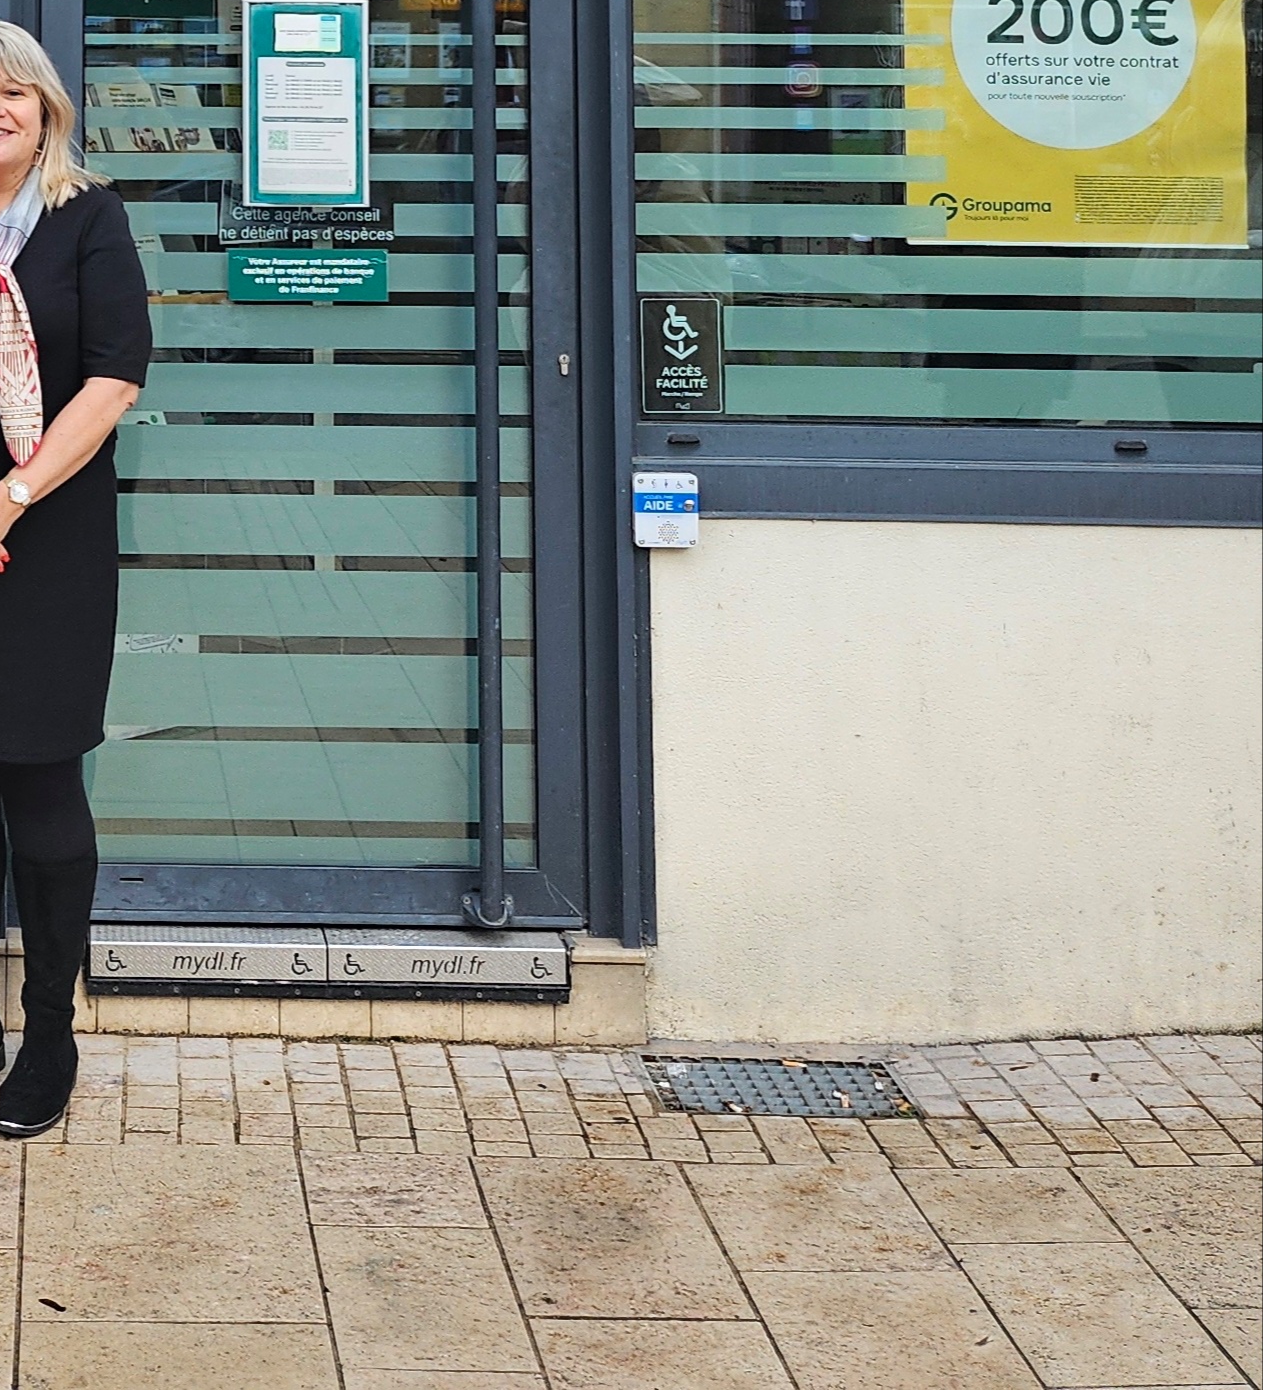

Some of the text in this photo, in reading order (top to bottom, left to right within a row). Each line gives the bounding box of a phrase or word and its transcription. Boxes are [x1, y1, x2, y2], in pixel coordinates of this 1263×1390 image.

[986, 53, 1180, 69] offerts sur votre contrat
[986, 72, 1111, 86] d'assurance vie
[987, 94, 1007, 102] pour
[1009, 92, 1033, 101] toute
[1034, 92, 1070, 101] nouvelle
[962, 197, 1052, 214] Groupama
[232, 206, 381, 224] Cette agence conseil
[964, 214, 991, 222] Toujours
[219, 226, 394, 242] ne détient pas d'espèces
[248, 257, 370, 266] Votre Assureur est mandataire
[242, 266, 274, 275] exclusif
[286, 266, 331, 276] opérations
[331, 267, 343, 275] de
[343, 267, 375, 277] banque
[323, 277, 363, 285] paiement
[291, 285, 340, 294] Franfinance
[661, 364, 702, 377] ACCÈS
[655, 376, 709, 389] FACILITÉ
[643, 500, 674, 511] AIDE
[172, 951, 247, 975] mydl.fr
[410, 955, 486, 978] mydl.fr
